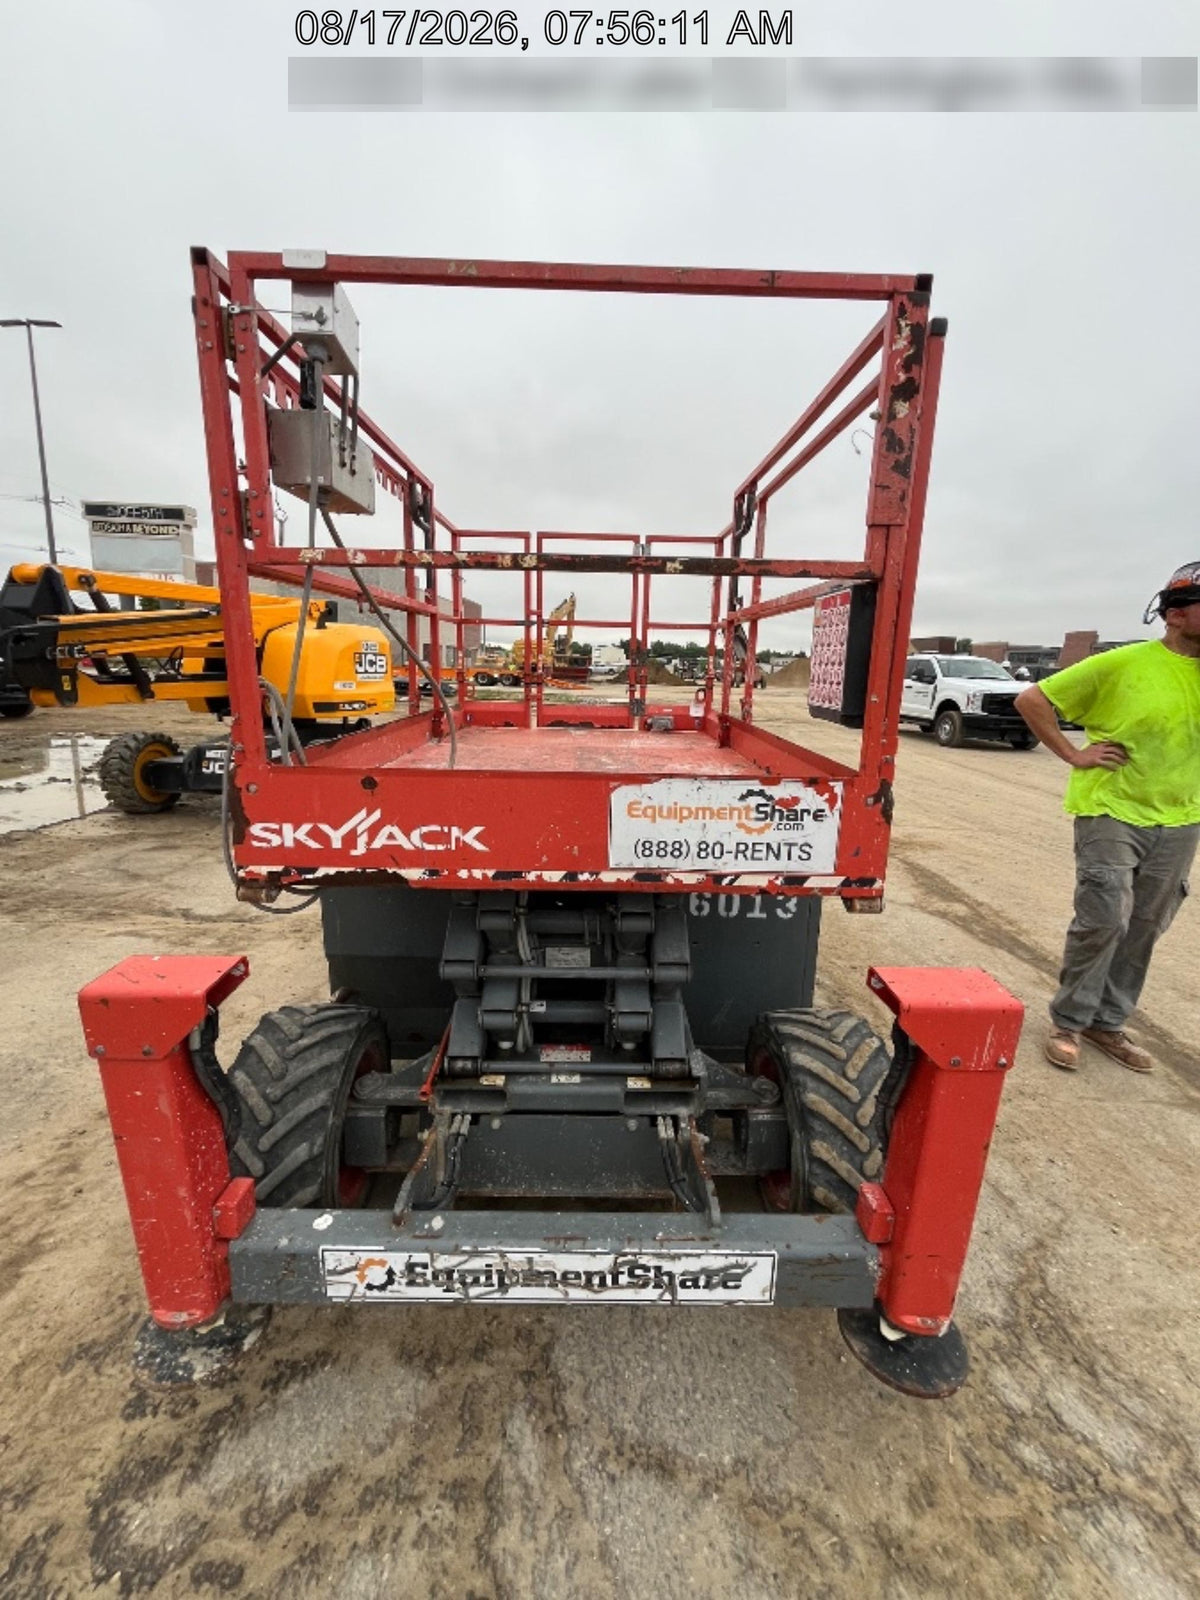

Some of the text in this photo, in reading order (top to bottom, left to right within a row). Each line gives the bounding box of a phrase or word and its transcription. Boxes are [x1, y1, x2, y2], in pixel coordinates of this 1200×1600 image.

[132, 524, 180, 535] BEYOND
[355, 653, 387, 673] JCB
[626, 800, 827, 824] EquipmentShare
[250, 807, 490, 856] SKYJACK
[772, 822, 804, 832] .com
[634, 839, 813, 861] (888) 80-RENTS
